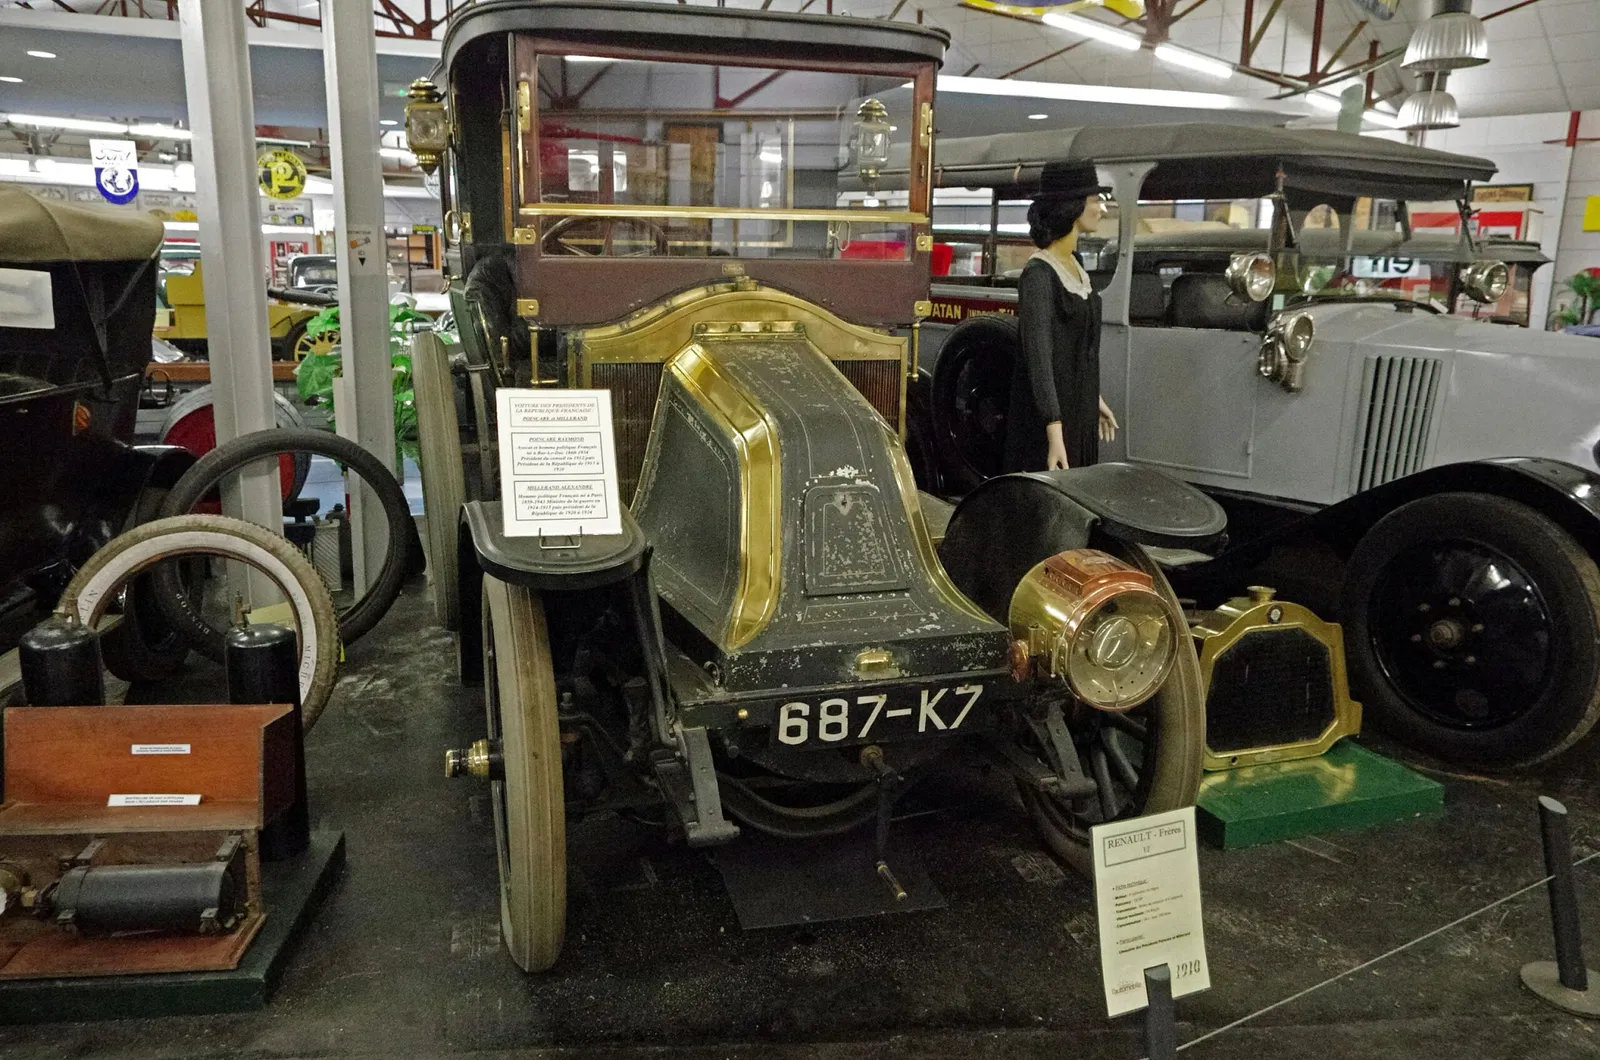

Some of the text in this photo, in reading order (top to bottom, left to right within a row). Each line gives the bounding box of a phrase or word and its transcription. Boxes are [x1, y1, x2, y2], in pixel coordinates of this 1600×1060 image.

[176, 593, 210, 635] DUNLOP
[777, 684, 984, 746] 687-K7
[1108, 831, 1152, 849] RENAULT
[1159, 826, 1182, 838] Frères
[1176, 959, 1201, 979] 1910
